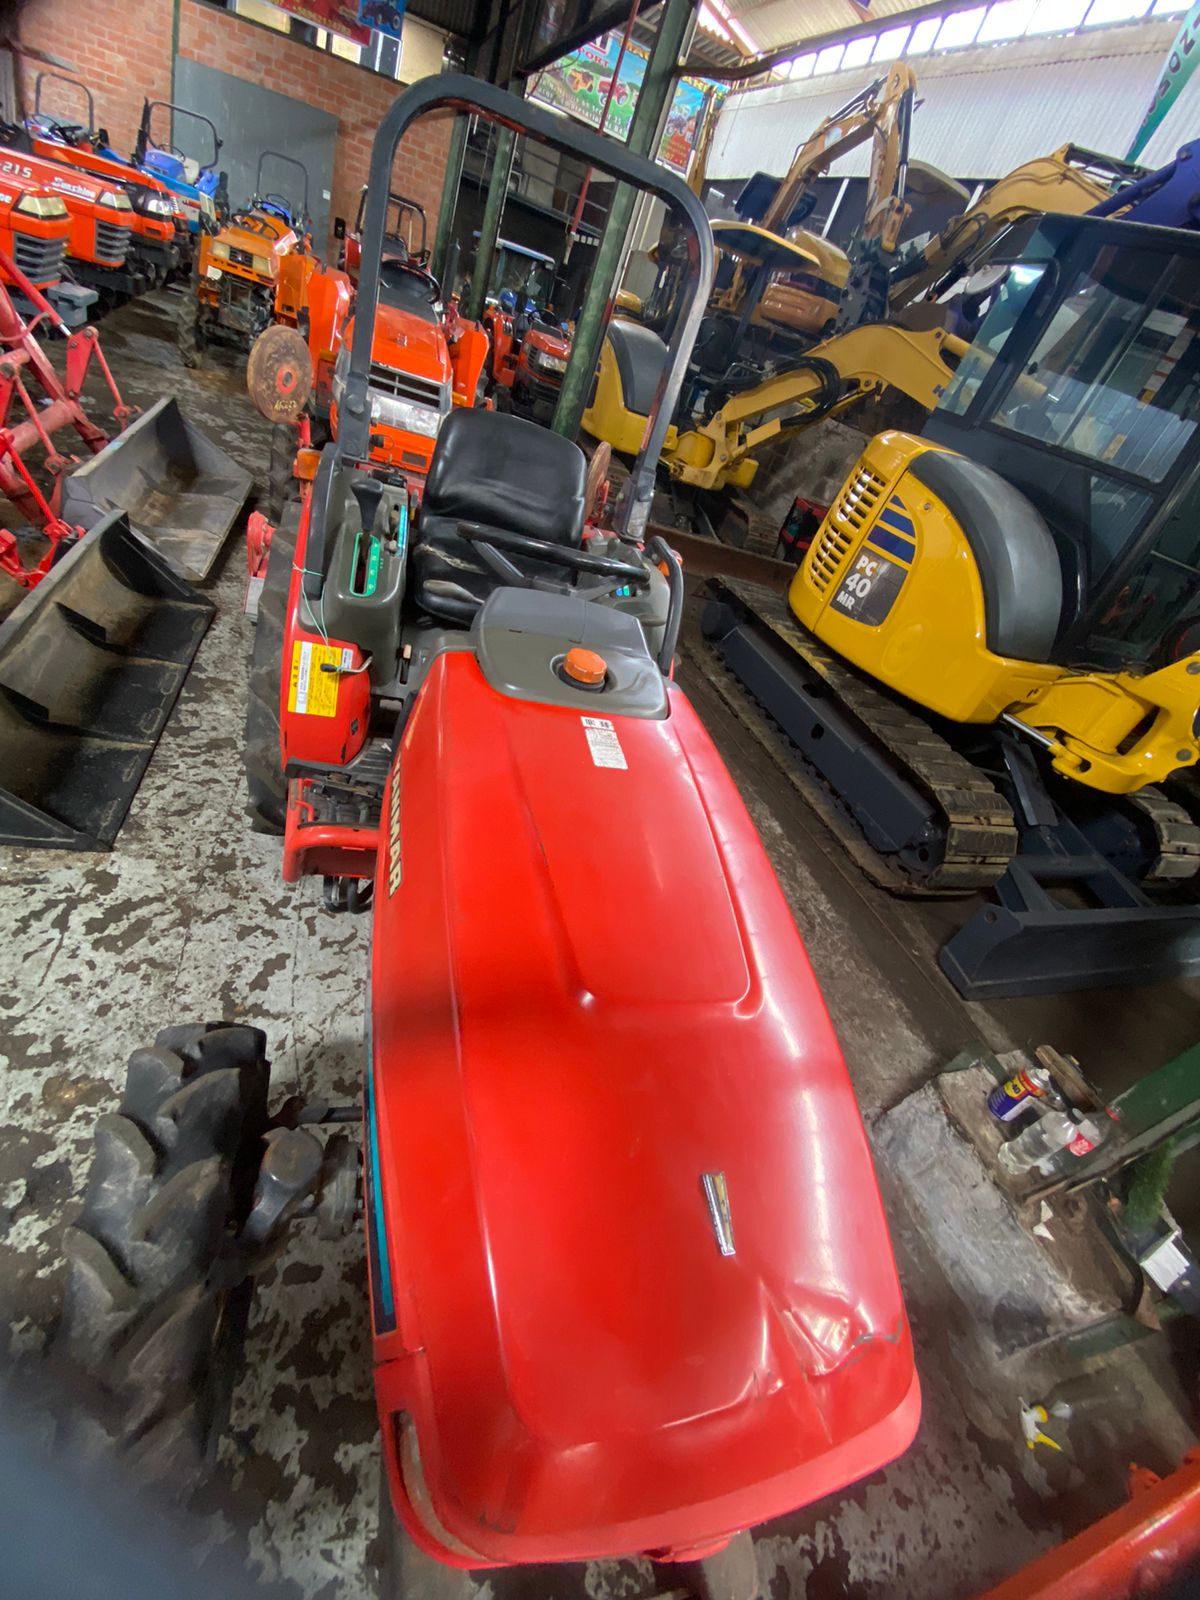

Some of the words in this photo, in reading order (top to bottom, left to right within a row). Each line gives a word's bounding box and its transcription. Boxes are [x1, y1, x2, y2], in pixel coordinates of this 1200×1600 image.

[578, 47, 609, 67] PORT
[855, 554, 878, 577] PC
[845, 573, 872, 598] 40
[836, 590, 856, 610] MR
